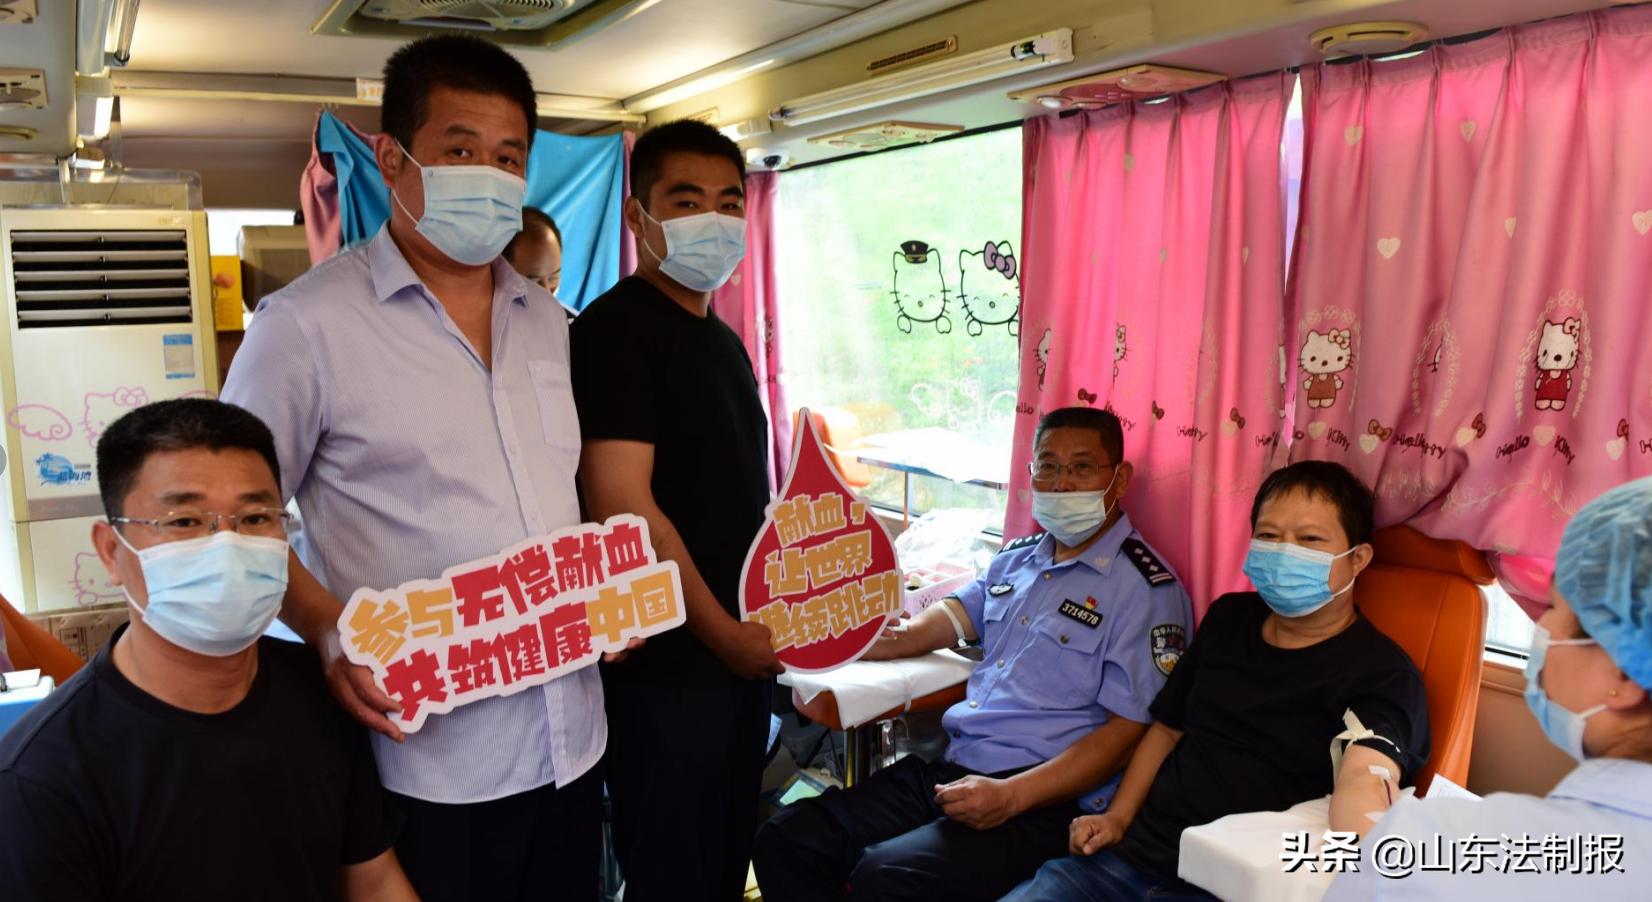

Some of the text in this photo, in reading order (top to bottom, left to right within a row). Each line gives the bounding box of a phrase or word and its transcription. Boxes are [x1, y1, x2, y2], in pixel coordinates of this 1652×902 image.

[348, 523, 649, 666] 参与无偿献血
[764, 530, 872, 598] 让世界
[1062, 602, 1099, 625] 3714578
[382, 569, 678, 722] 共筑健康中国
